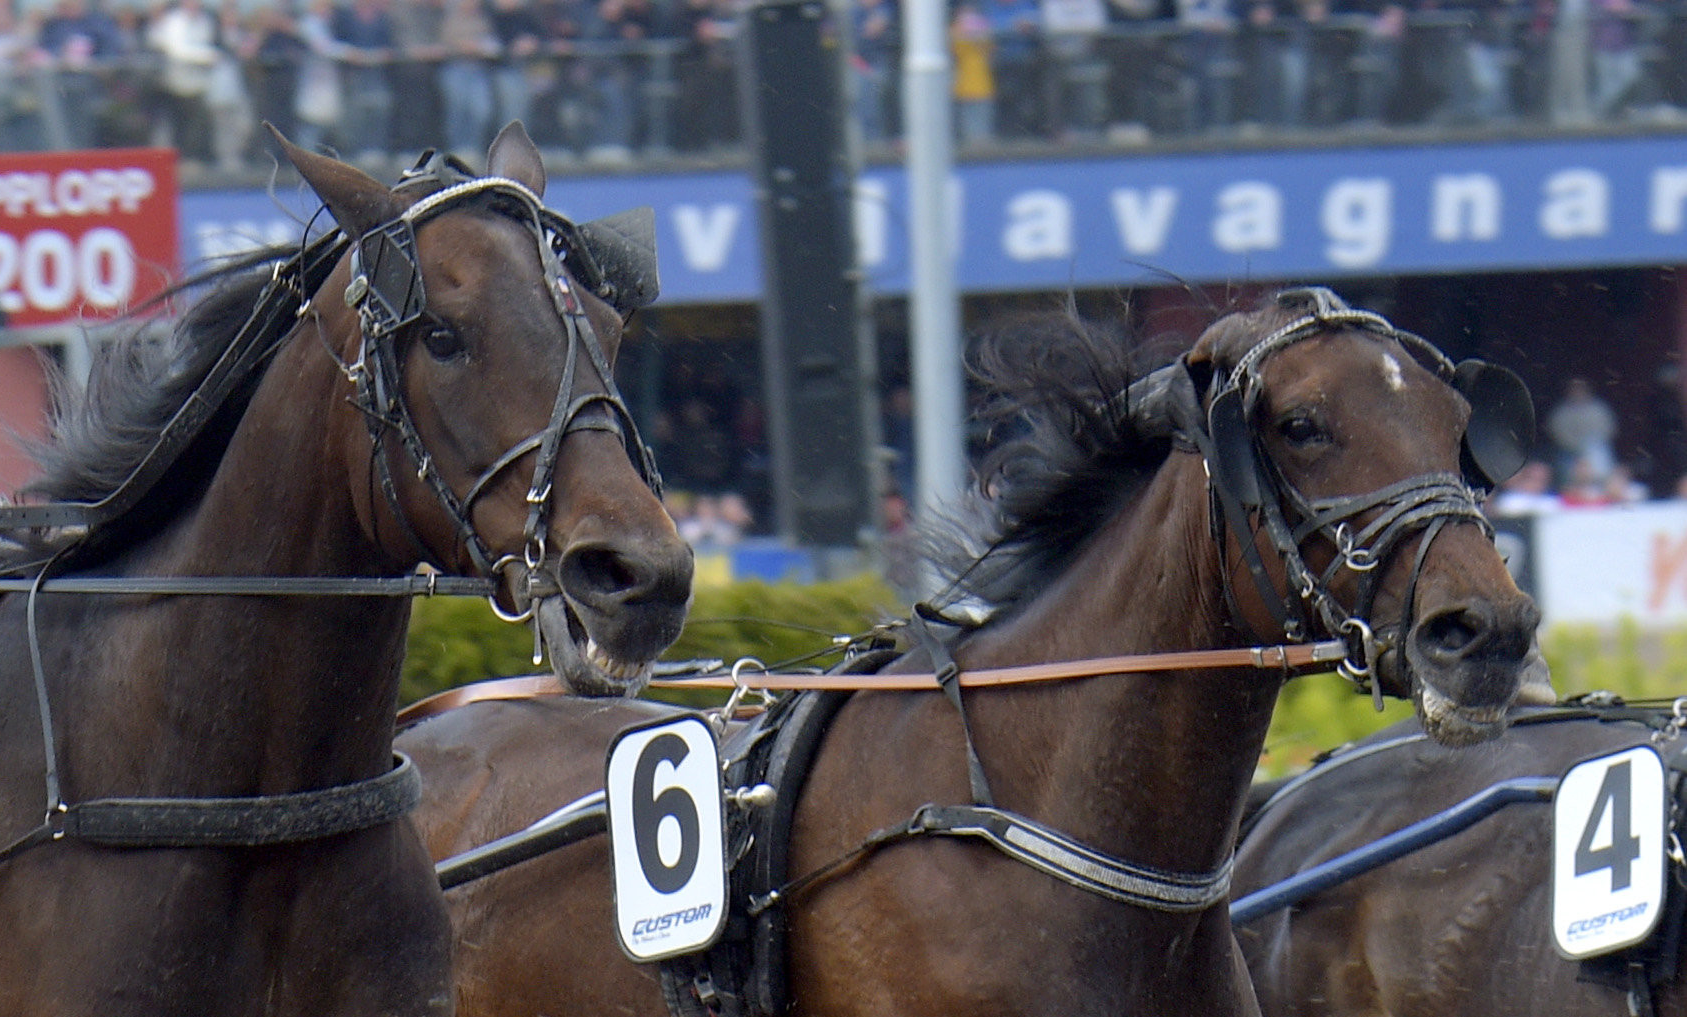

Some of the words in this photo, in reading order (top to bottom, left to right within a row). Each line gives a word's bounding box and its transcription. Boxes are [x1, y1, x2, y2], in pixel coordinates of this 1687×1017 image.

[632, 732, 700, 895] 6
[1574, 758, 1640, 893] 4
[632, 903, 713, 936] CUSTOM
[1567, 901, 1648, 936] CUSTOM
